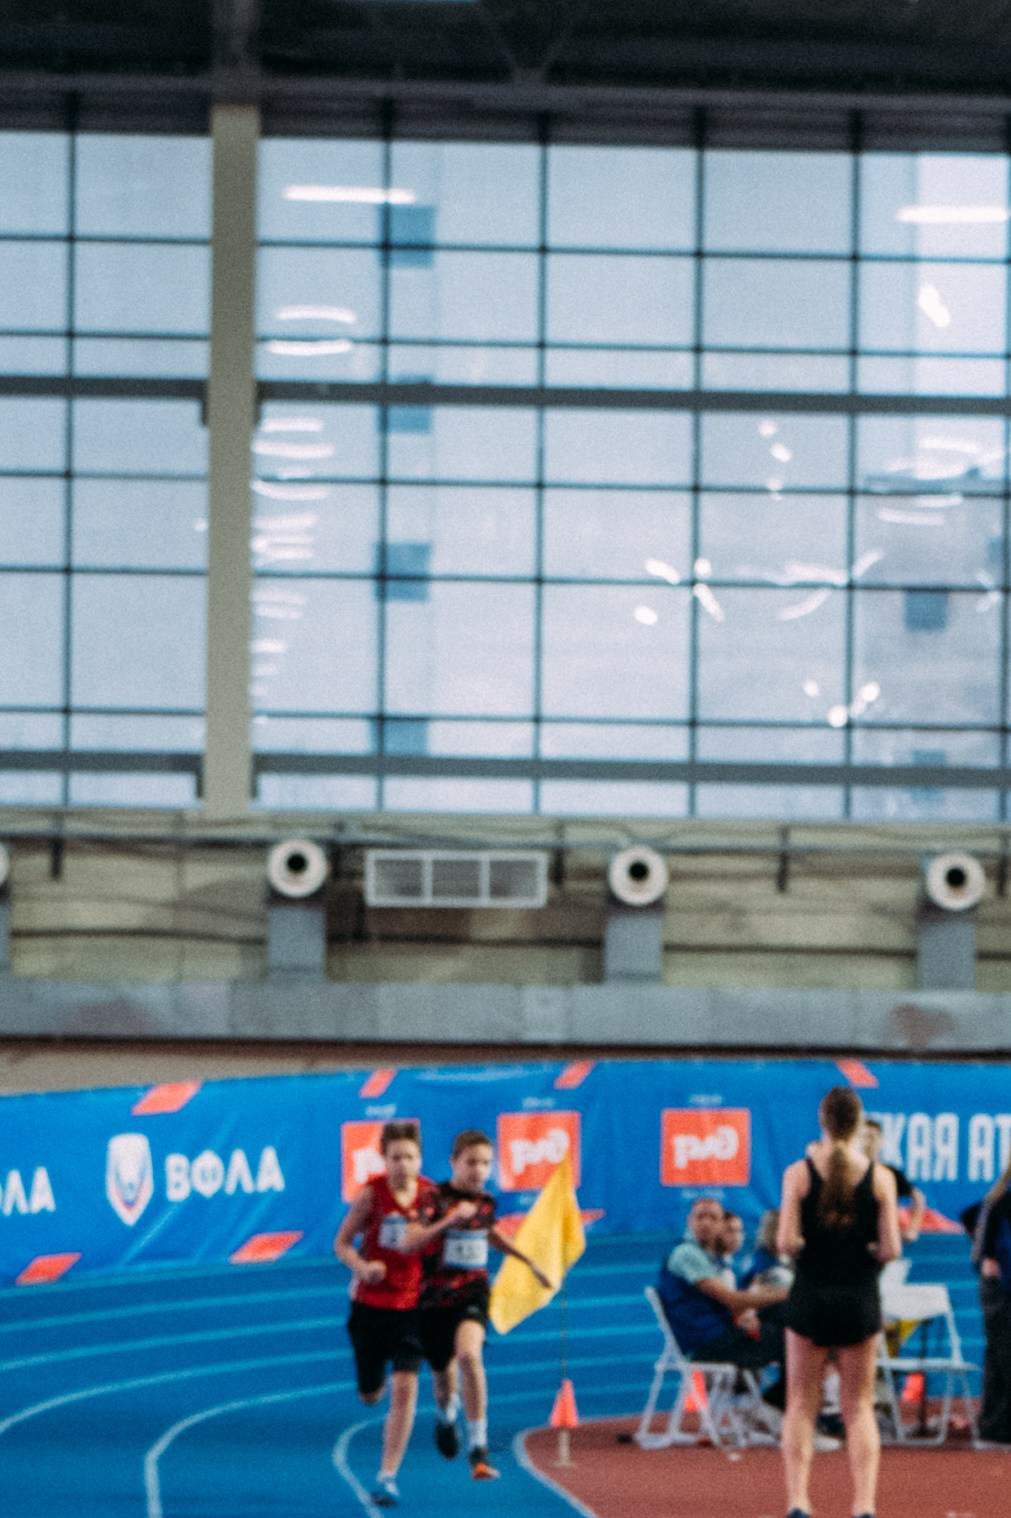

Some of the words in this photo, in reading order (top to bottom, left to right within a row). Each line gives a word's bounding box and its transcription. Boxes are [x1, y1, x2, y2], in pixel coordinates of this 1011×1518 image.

[165, 1146, 285, 1202] ВФЛА
[867, 1112, 958, 1182] КАЯ
[0, 1166, 56, 1216] ЛА
